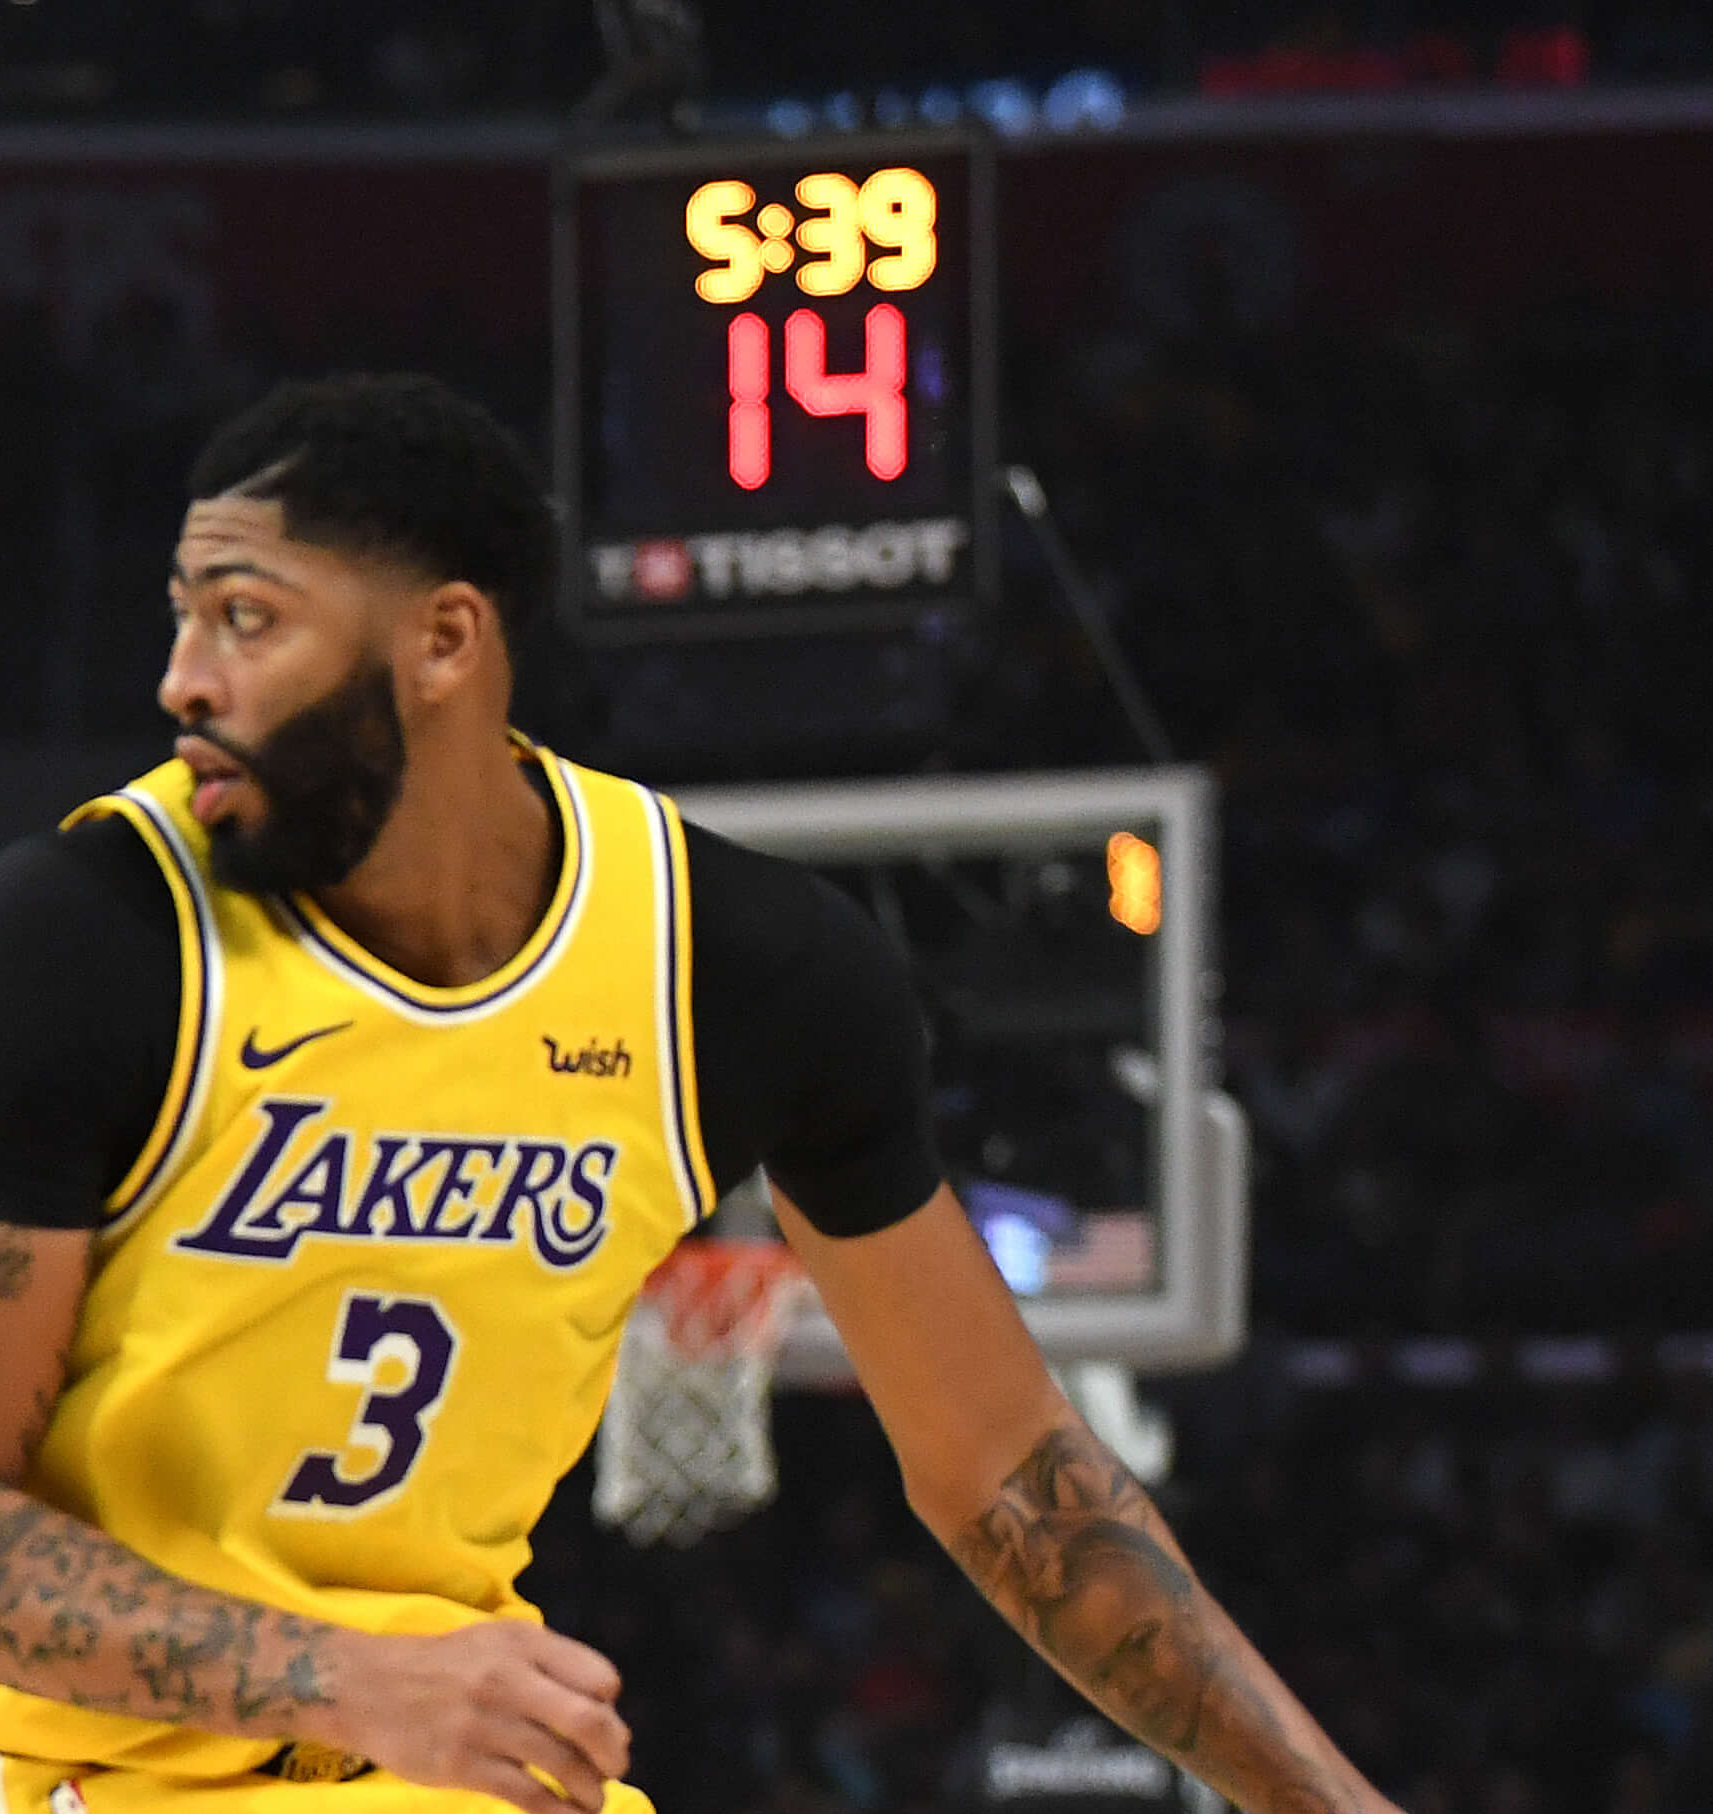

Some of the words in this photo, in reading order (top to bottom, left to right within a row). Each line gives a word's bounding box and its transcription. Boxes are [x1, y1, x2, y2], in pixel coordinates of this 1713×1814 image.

[685, 166, 938, 305] 5:39
[727, 302, 909, 491] 14
[692, 514, 970, 600] TISSOT
[542, 1036, 631, 1078] wish
[174, 1101, 618, 1268] LAKERS
[278, 1296, 455, 1508] 3
